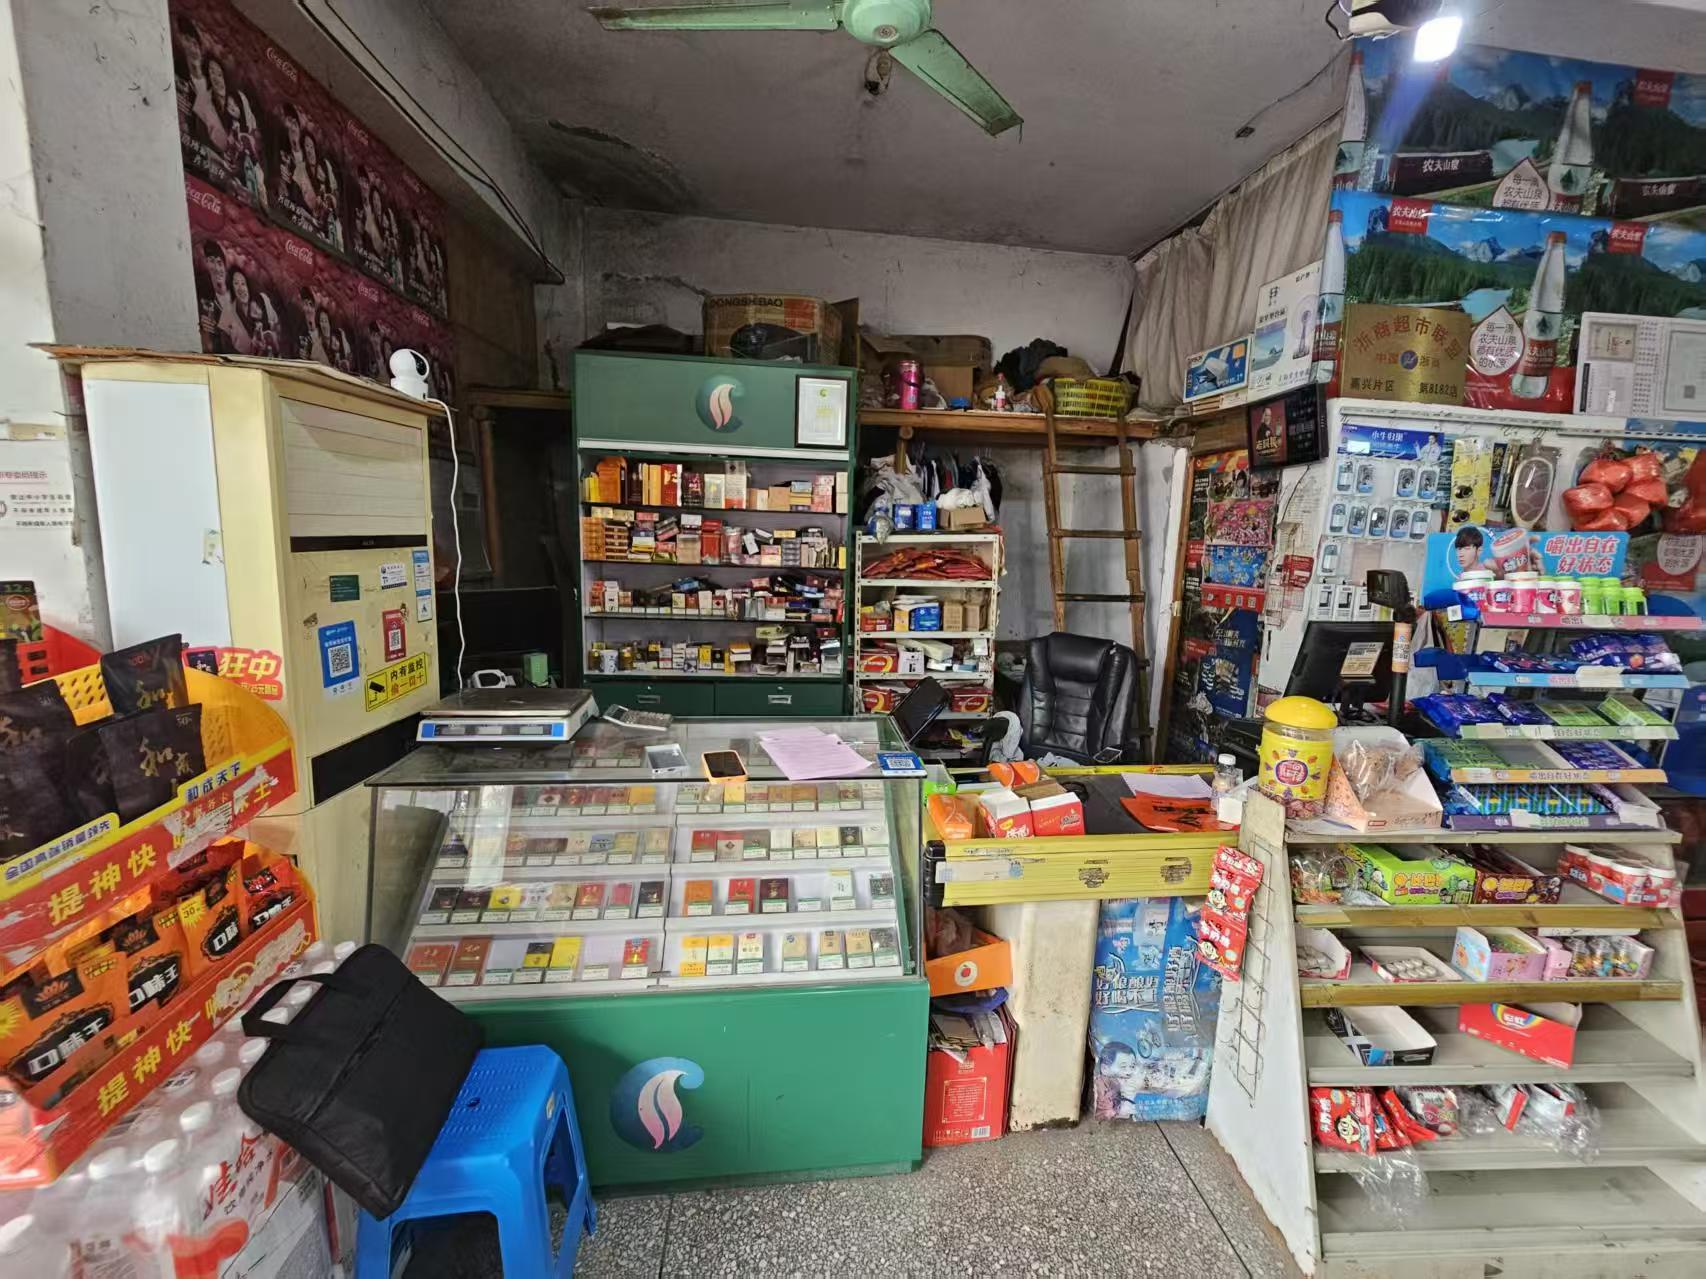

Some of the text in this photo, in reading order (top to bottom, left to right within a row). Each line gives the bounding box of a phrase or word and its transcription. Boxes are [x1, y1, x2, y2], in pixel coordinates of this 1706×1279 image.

[1421, 157, 1460, 174] 农夫山泉
[1503, 186, 1543, 200] 农夫山泉
[1391, 206, 1427, 219] 农夫山泉
[1610, 226, 1646, 241] 农夫山泉
[1352, 315, 1464, 360] 浙商超市联盟
[1487, 322, 1515, 334] 每一滴
[1479, 333, 1518, 346] 农夫山泉
[1476, 345, 1517, 358] 都有优质
[1418, 382, 1458, 398] 第8182店
[1545, 535, 1620, 555] 嚼出自在
[1557, 555, 1613, 574] 好状态
[217, 652, 277, 682] 狂中
[389, 657, 424, 682] 内有监控
[390, 672, 424, 697] 偷一罚十
[187, 761, 242, 801] 和成天下
[4, 820, 111, 881] 全国高端销量领先
[49, 842, 158, 927] 提神快
[98, 1020, 193, 1116] 提神快
